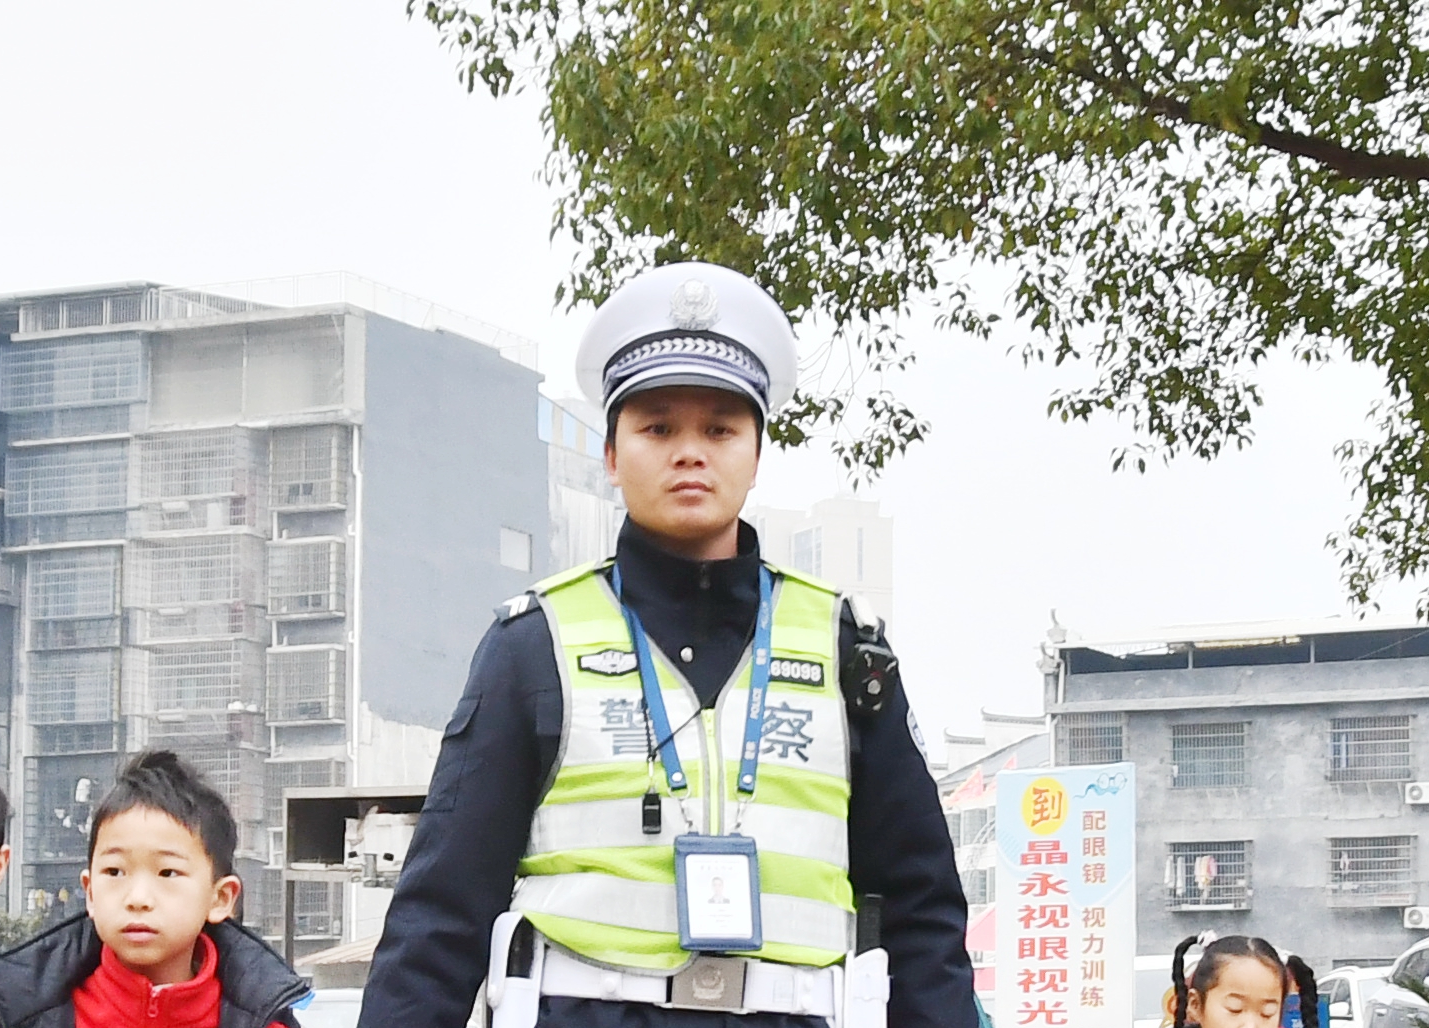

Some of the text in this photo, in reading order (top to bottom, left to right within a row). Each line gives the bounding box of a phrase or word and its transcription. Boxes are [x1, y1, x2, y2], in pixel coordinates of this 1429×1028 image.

[768, 660, 822, 682] 69098
[599, 699, 814, 762] 警 察
[1030, 786, 1063, 828] 到
[1016, 839, 1070, 1025] 晶永视眼视光
[1080, 810, 1106, 1008] 配眼镜 视力训练
